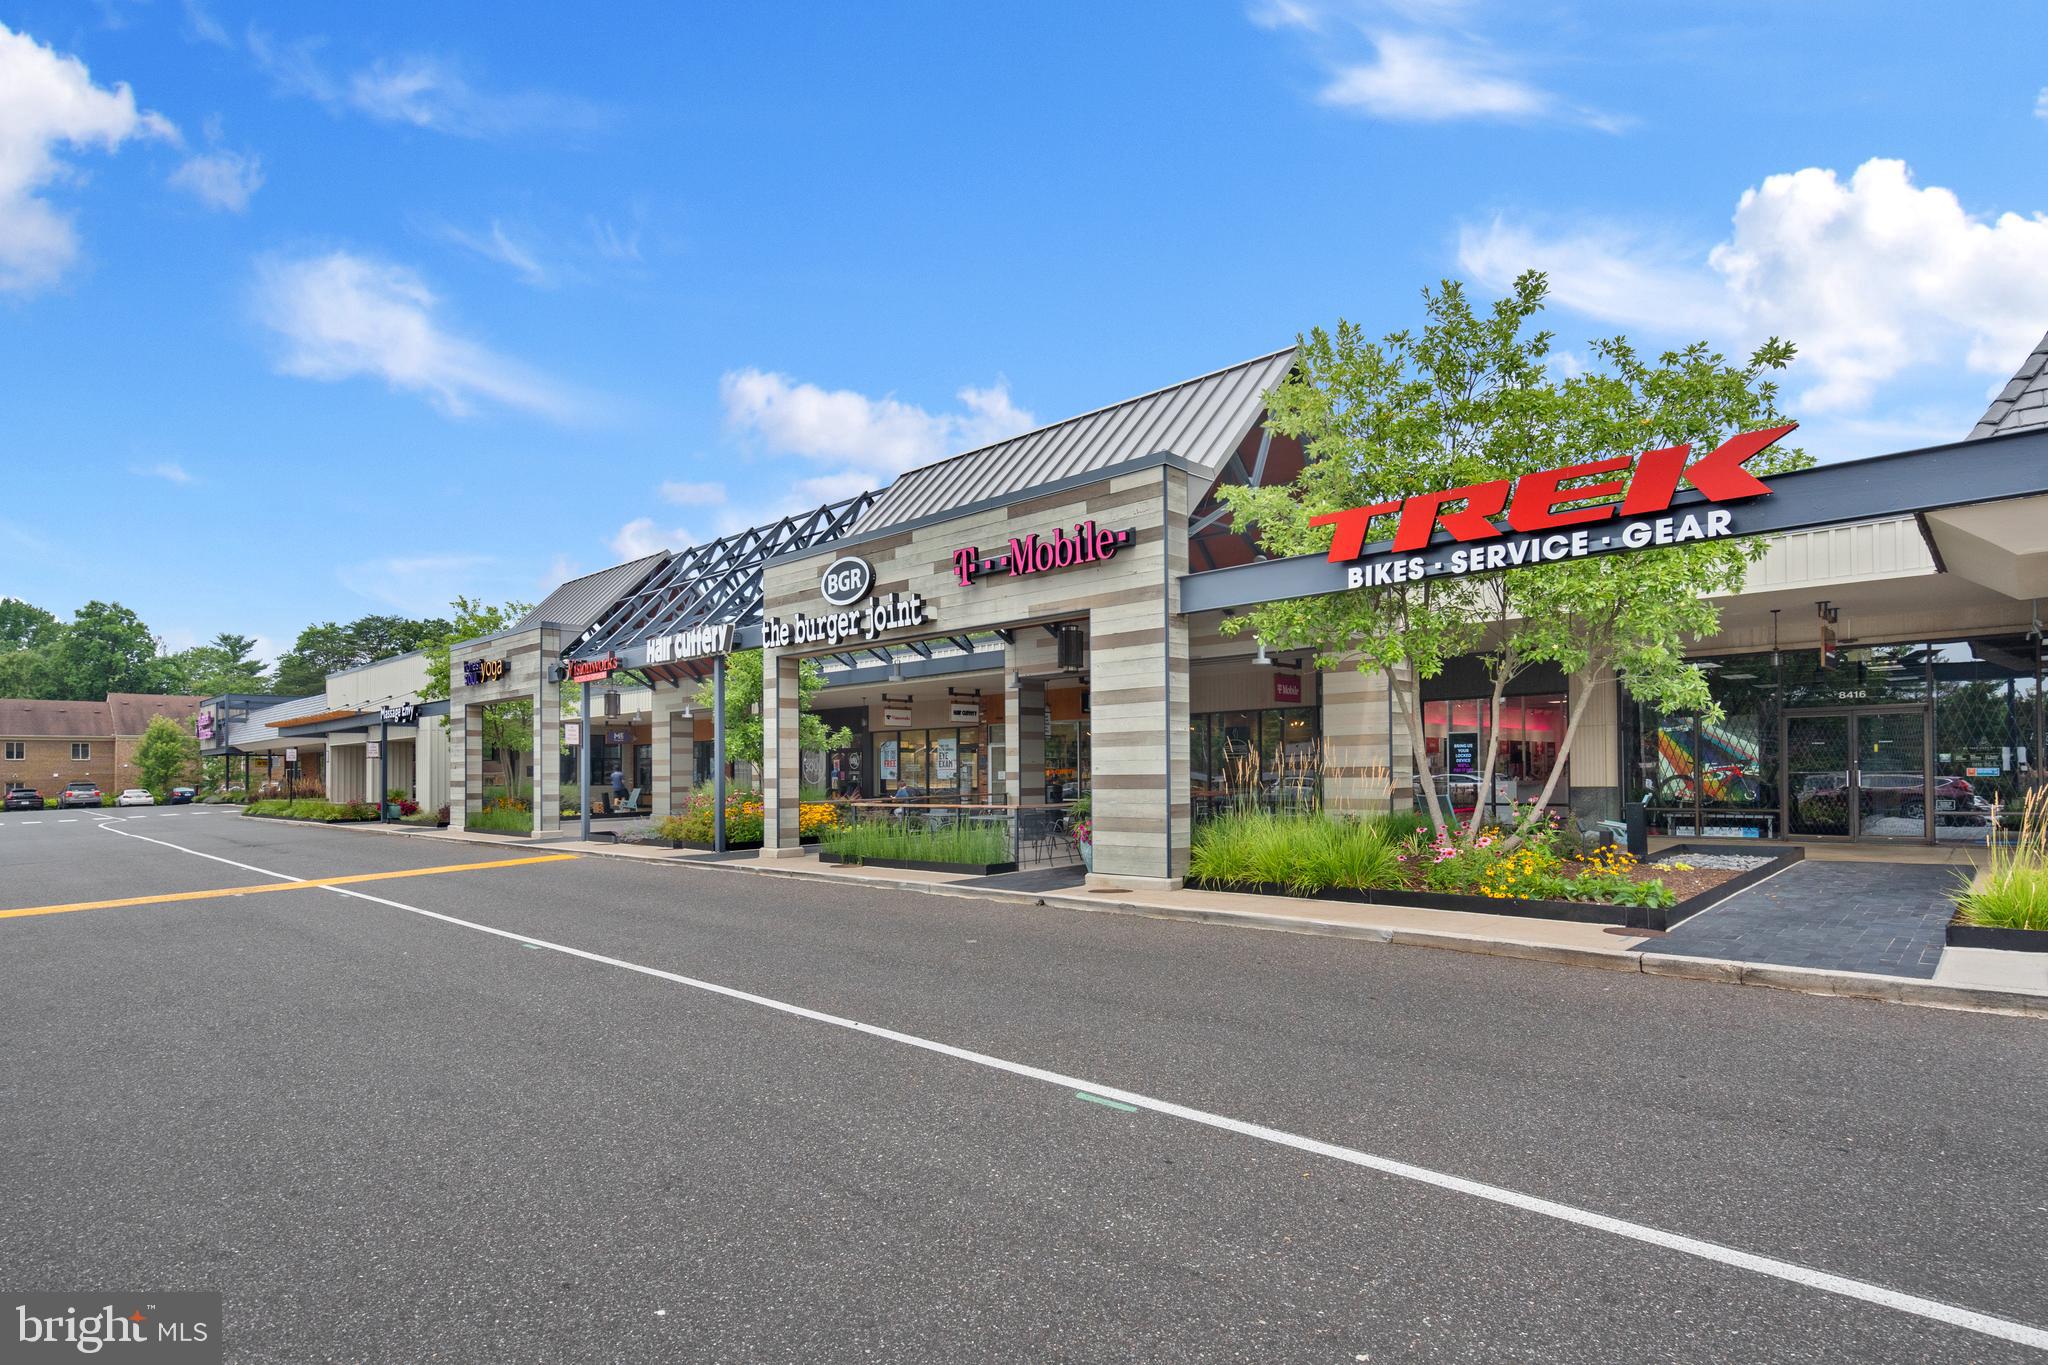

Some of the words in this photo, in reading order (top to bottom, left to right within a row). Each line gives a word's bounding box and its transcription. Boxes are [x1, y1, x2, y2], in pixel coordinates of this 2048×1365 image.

[1309, 422, 1799, 564] TREK
[1347, 557, 1425, 590] BIKES
[1450, 531, 1589, 574] SERVICE
[1621, 509, 1732, 548] GEAR
[827, 568, 862, 595] BGR
[762, 617, 790, 648] the
[794, 609, 860, 645] burger
[865, 592, 922, 640] joint
[646, 635, 672, 663] Hair
[674, 622, 729, 659] cuttery
[480, 658, 503, 683] yoga
[1839, 690, 1866, 699] 8416
[380, 705, 401, 723] Massage
[884, 760, 896, 768] FREE
